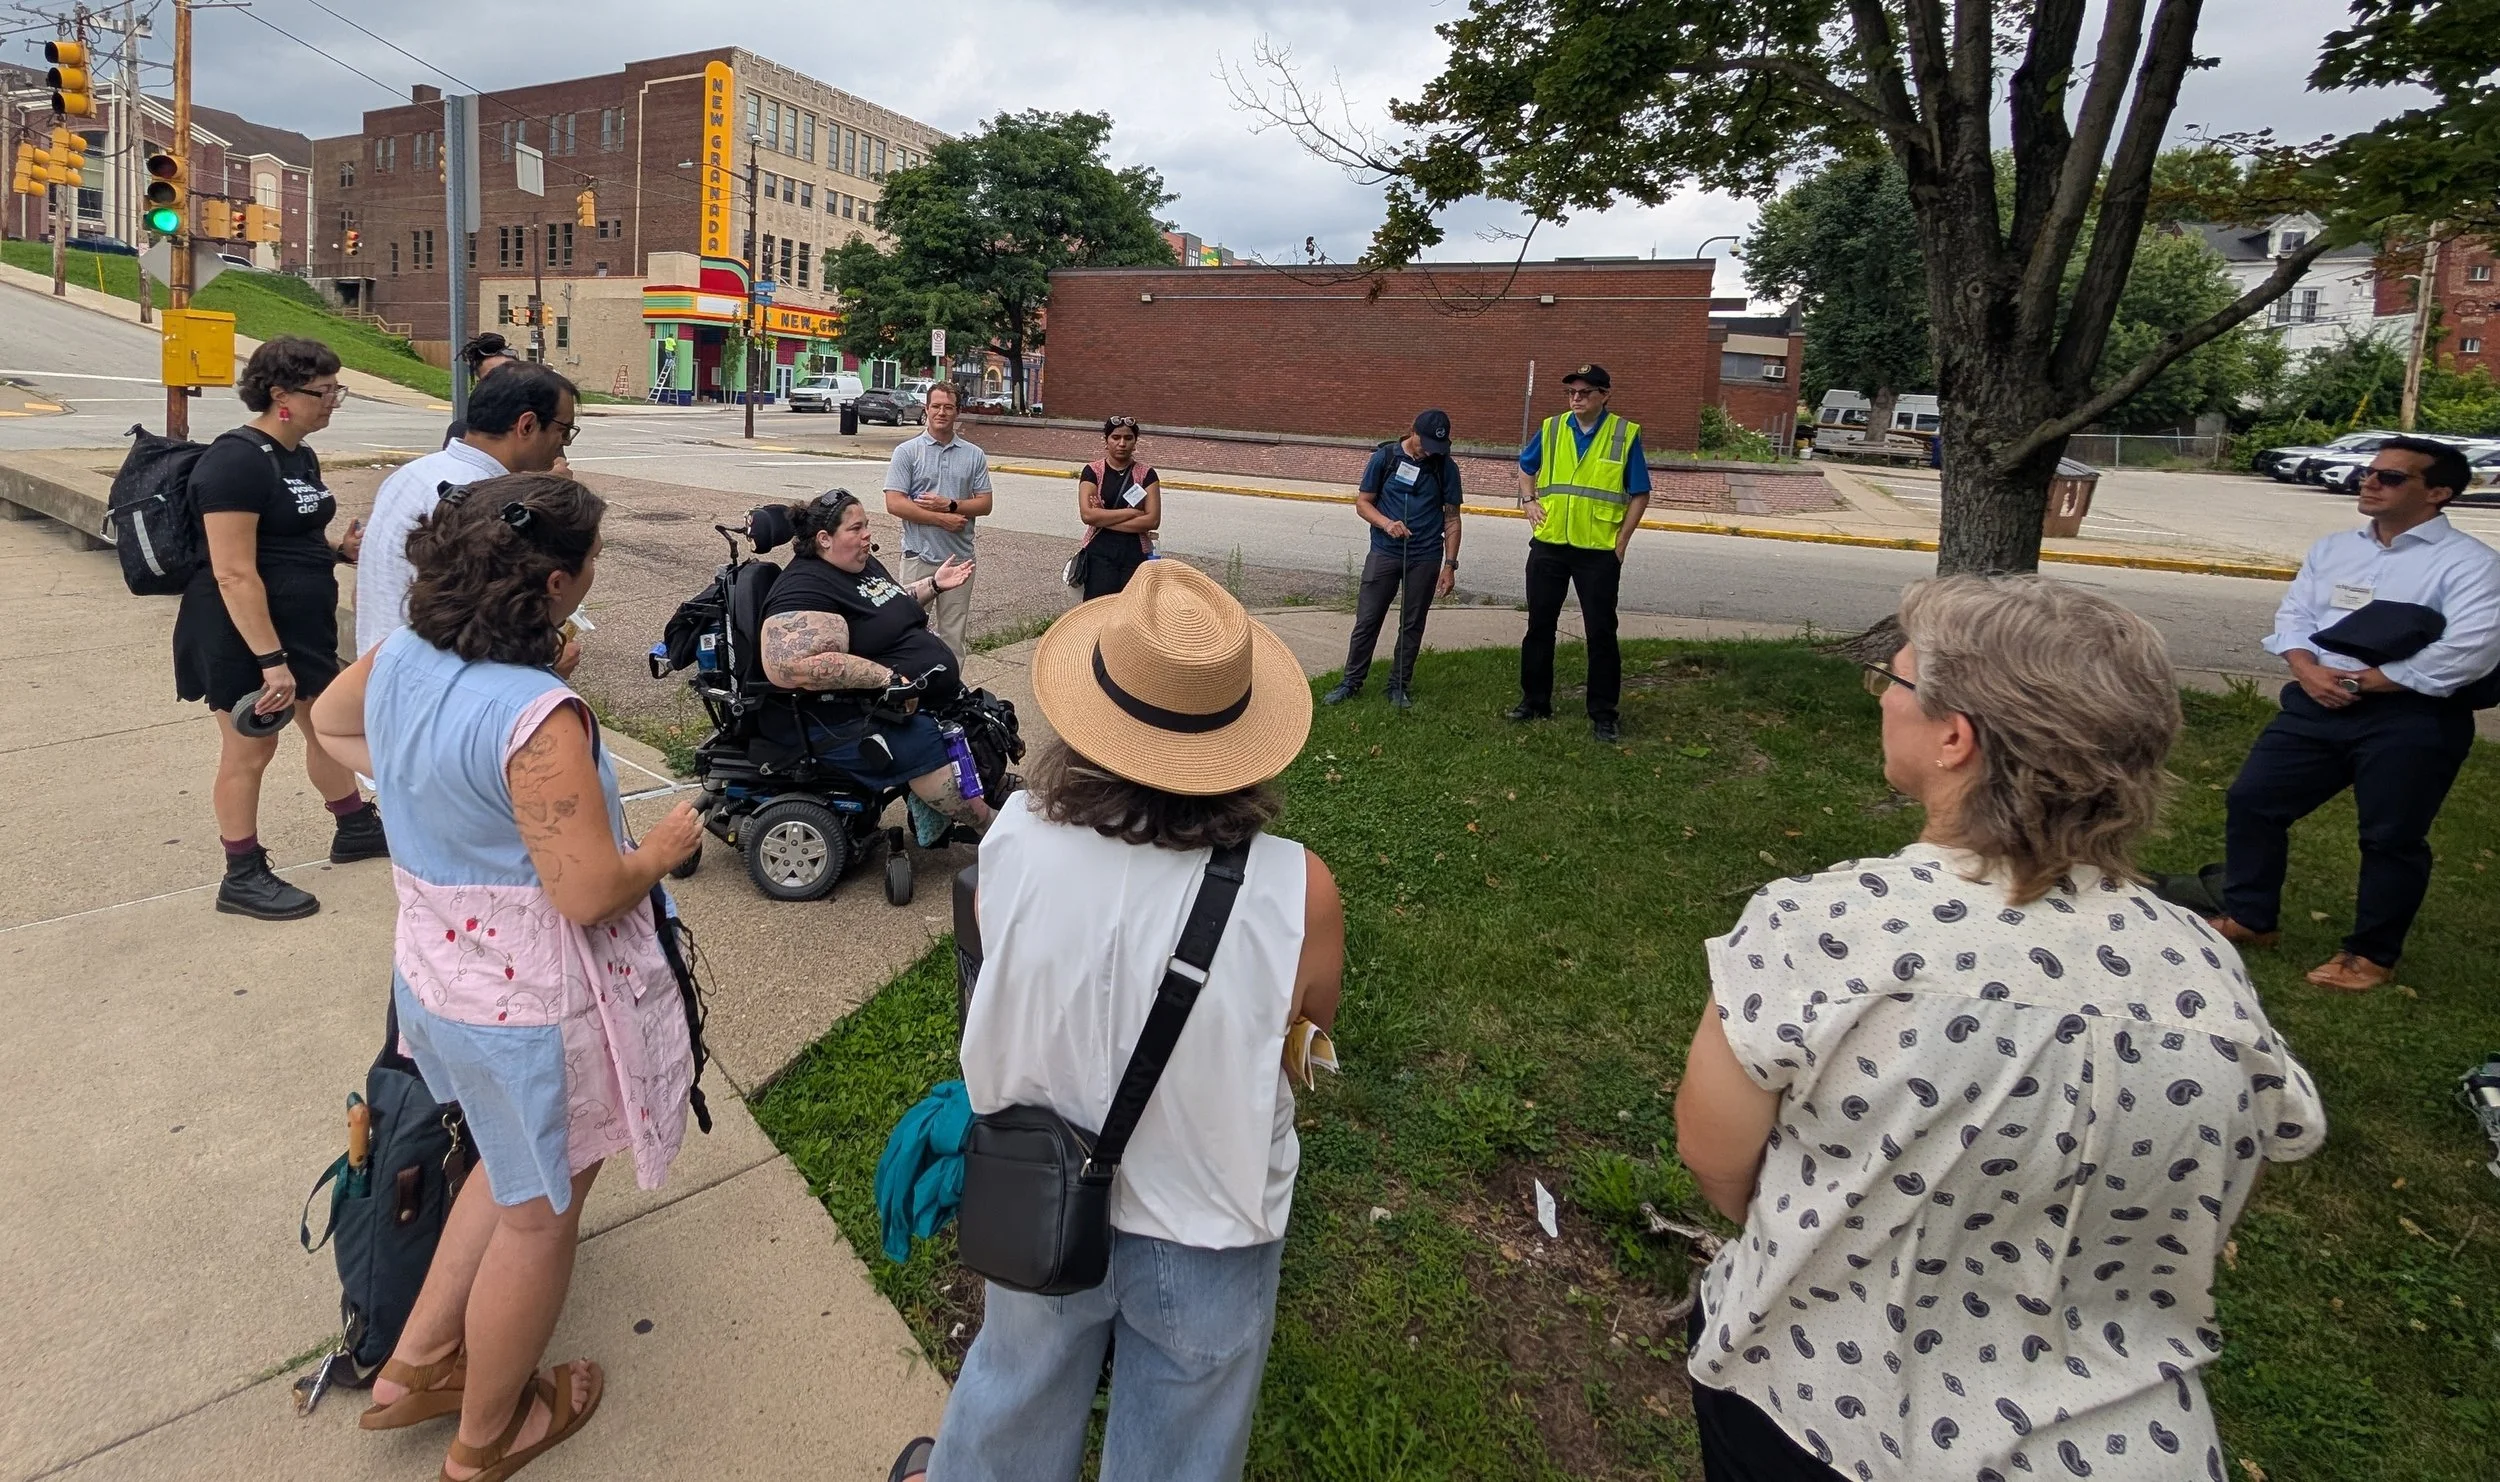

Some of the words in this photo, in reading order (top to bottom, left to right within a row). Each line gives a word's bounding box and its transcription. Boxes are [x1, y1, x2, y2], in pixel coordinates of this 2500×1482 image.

[710, 78, 724, 127] NEW
[708, 135, 722, 251] GRANADA
[781, 313, 811, 330] NEW
[1108, 1052, 1161, 1138] DKNY
